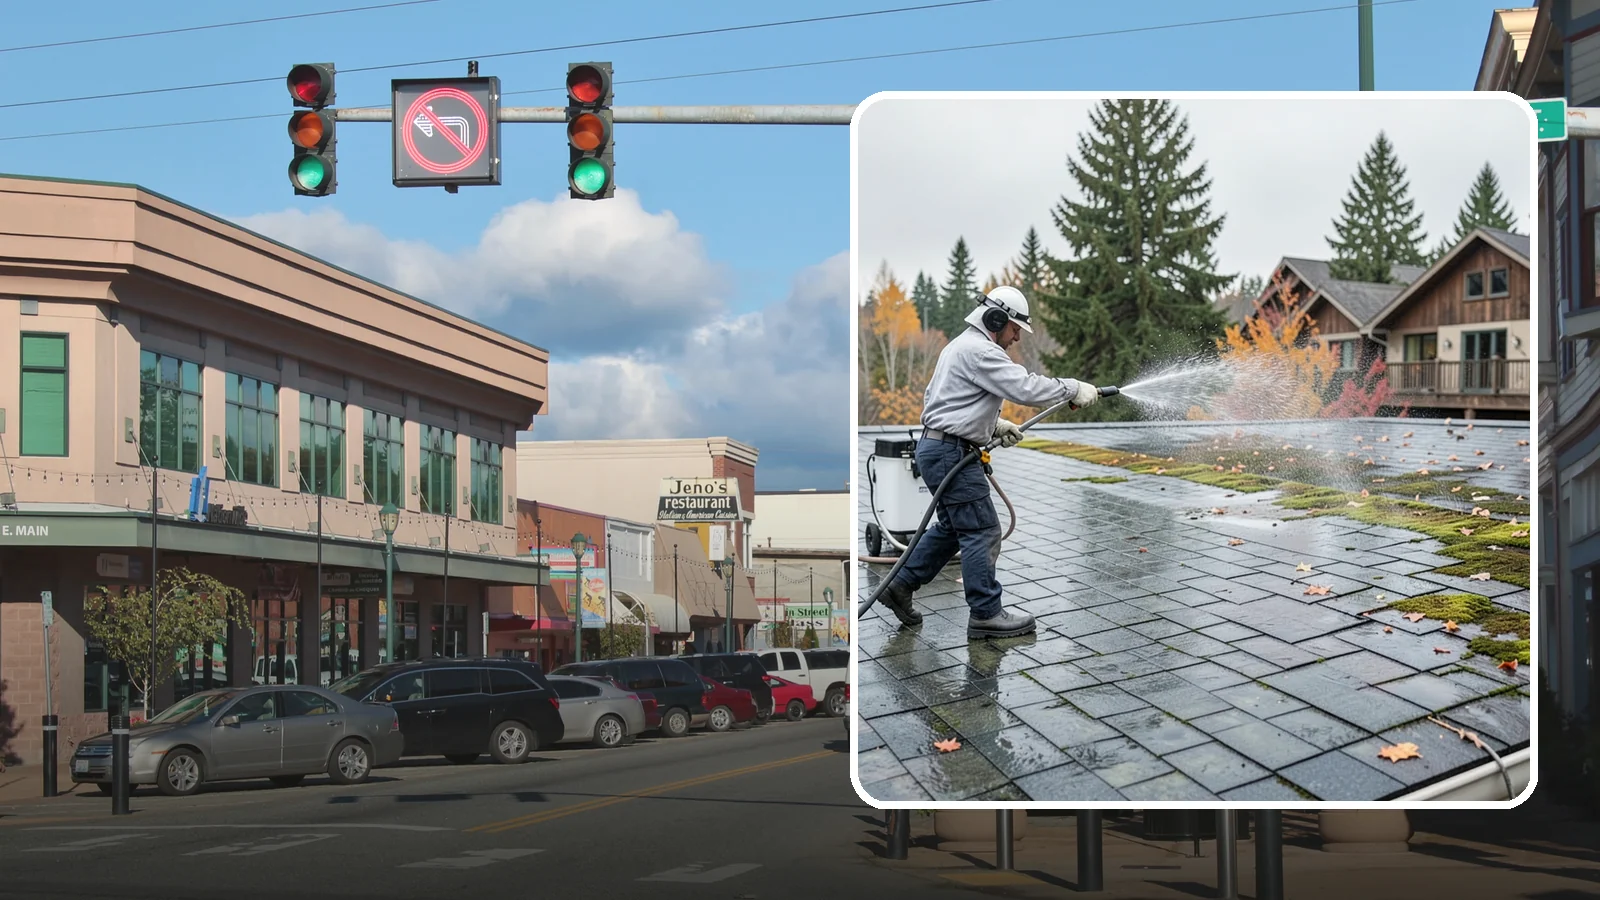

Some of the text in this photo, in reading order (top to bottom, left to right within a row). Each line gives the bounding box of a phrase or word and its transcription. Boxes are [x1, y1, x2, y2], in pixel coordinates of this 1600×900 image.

[670, 480, 727, 494] Jeno's
[665, 496, 731, 509] restaurant
[658, 510, 682, 519] Italian
[686, 509, 715, 519] American
[715, 509, 737, 519] Cuisine
[2, 525, 49, 536] E. MAIN
[797, 608, 829, 617] Street
[791, 619, 823, 627] lass
